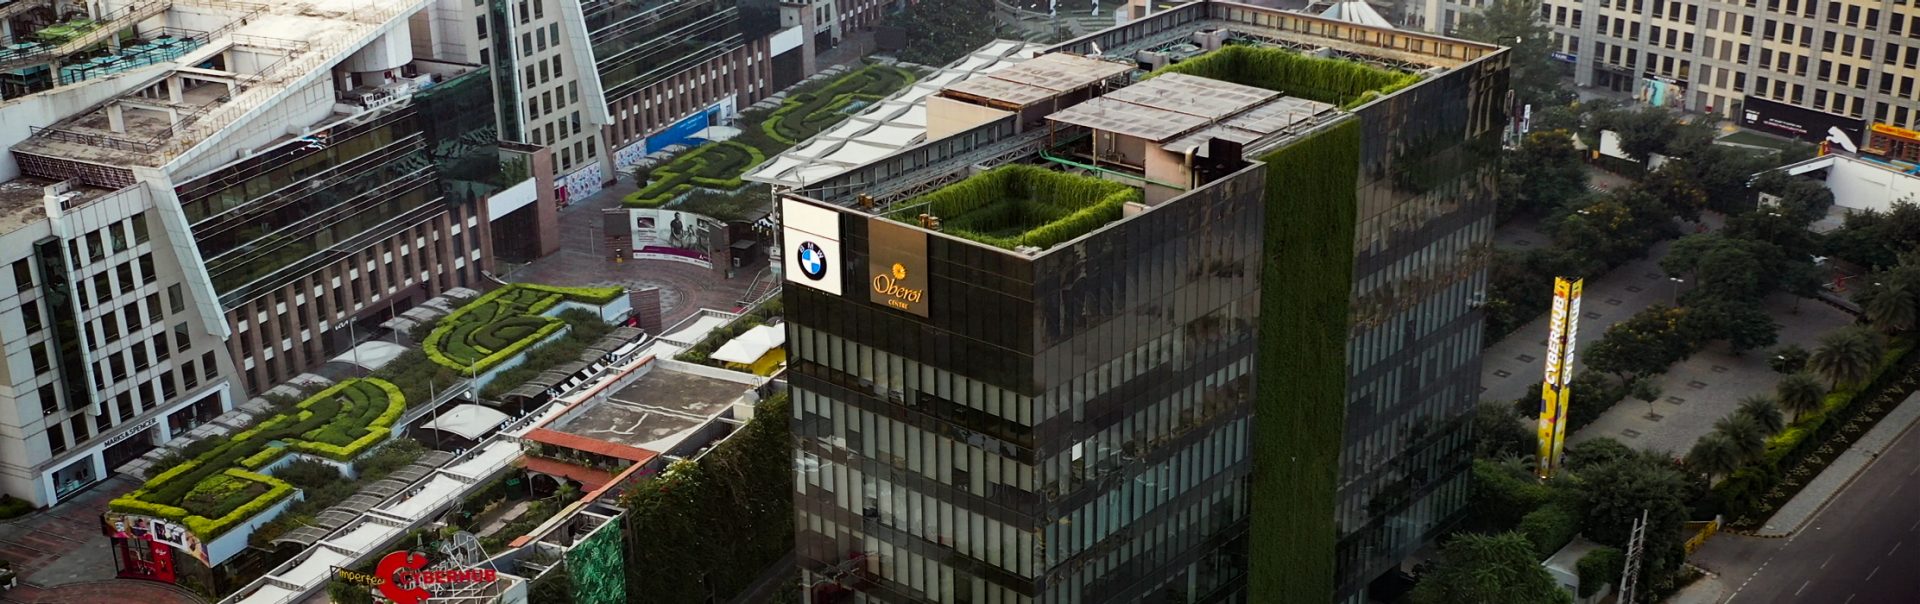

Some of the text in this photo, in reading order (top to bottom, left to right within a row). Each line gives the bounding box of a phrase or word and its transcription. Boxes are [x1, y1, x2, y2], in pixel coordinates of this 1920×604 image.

[873, 274, 923, 303] Oberoi
[1545, 295, 1564, 385] CYBERHUB
[1563, 296, 1581, 385] CYBERHUB
[399, 569, 497, 585] CYBERHUB
